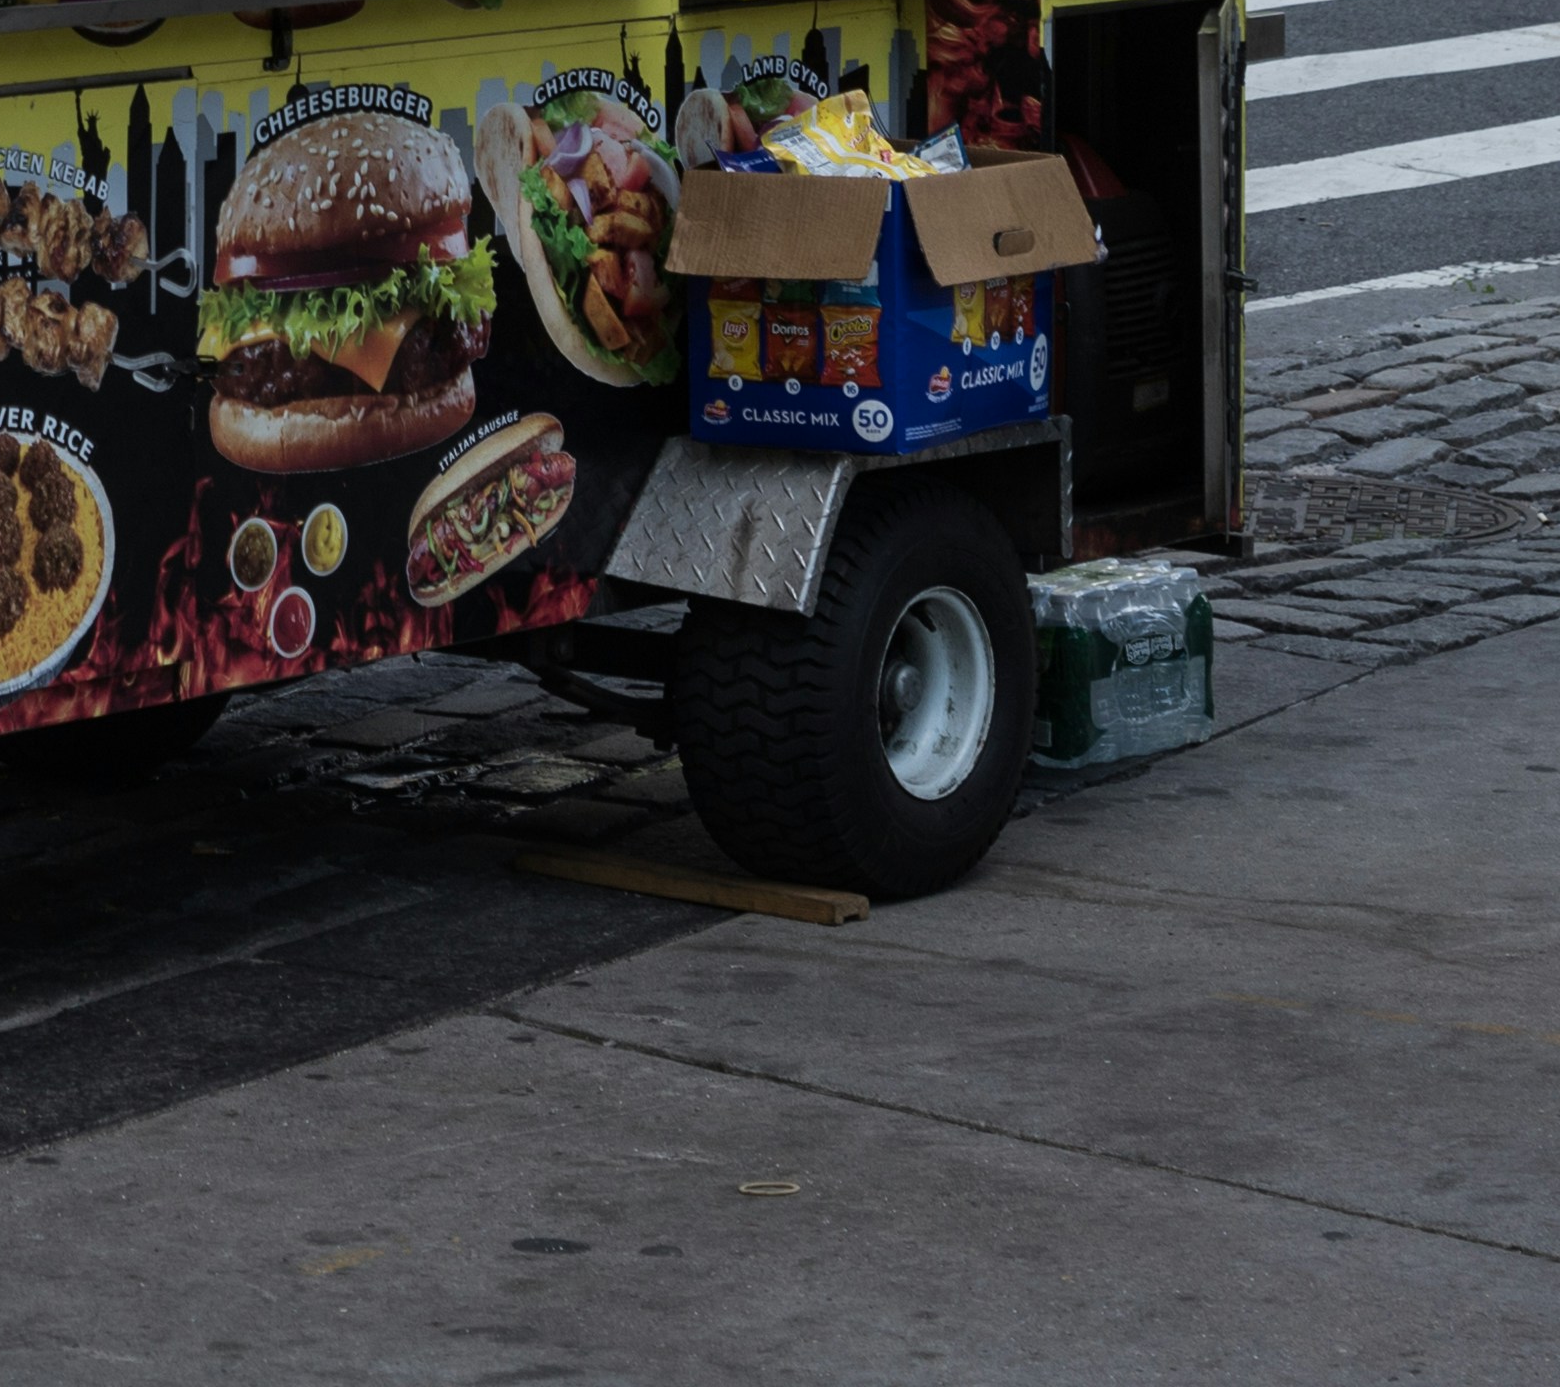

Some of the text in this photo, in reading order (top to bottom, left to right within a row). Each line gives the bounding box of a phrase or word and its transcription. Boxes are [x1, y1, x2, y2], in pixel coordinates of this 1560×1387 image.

[742, 57, 829, 99] LAMB GYRO
[534, 67, 660, 129] CHICKEN GYRO
[49, 159, 110, 202] KEBAB
[723, 320, 747, 340] Lay's
[771, 323, 809, 337] Doritos
[829, 315, 873, 343] Cheetos
[1032, 345, 1046, 374] 50
[731, 378, 739, 388] 6
[788, 381, 798, 392] 10
[961, 360, 1025, 390] CLASSIC MIX
[846, 384, 857, 395] 16
[742, 408, 806, 425] CLASSIC
[811, 412, 840, 427] MIX
[858, 409, 889, 429] 50
[41, 413, 94, 463] RICE
[439, 409, 519, 474] ITALIAN SAUSAGE
